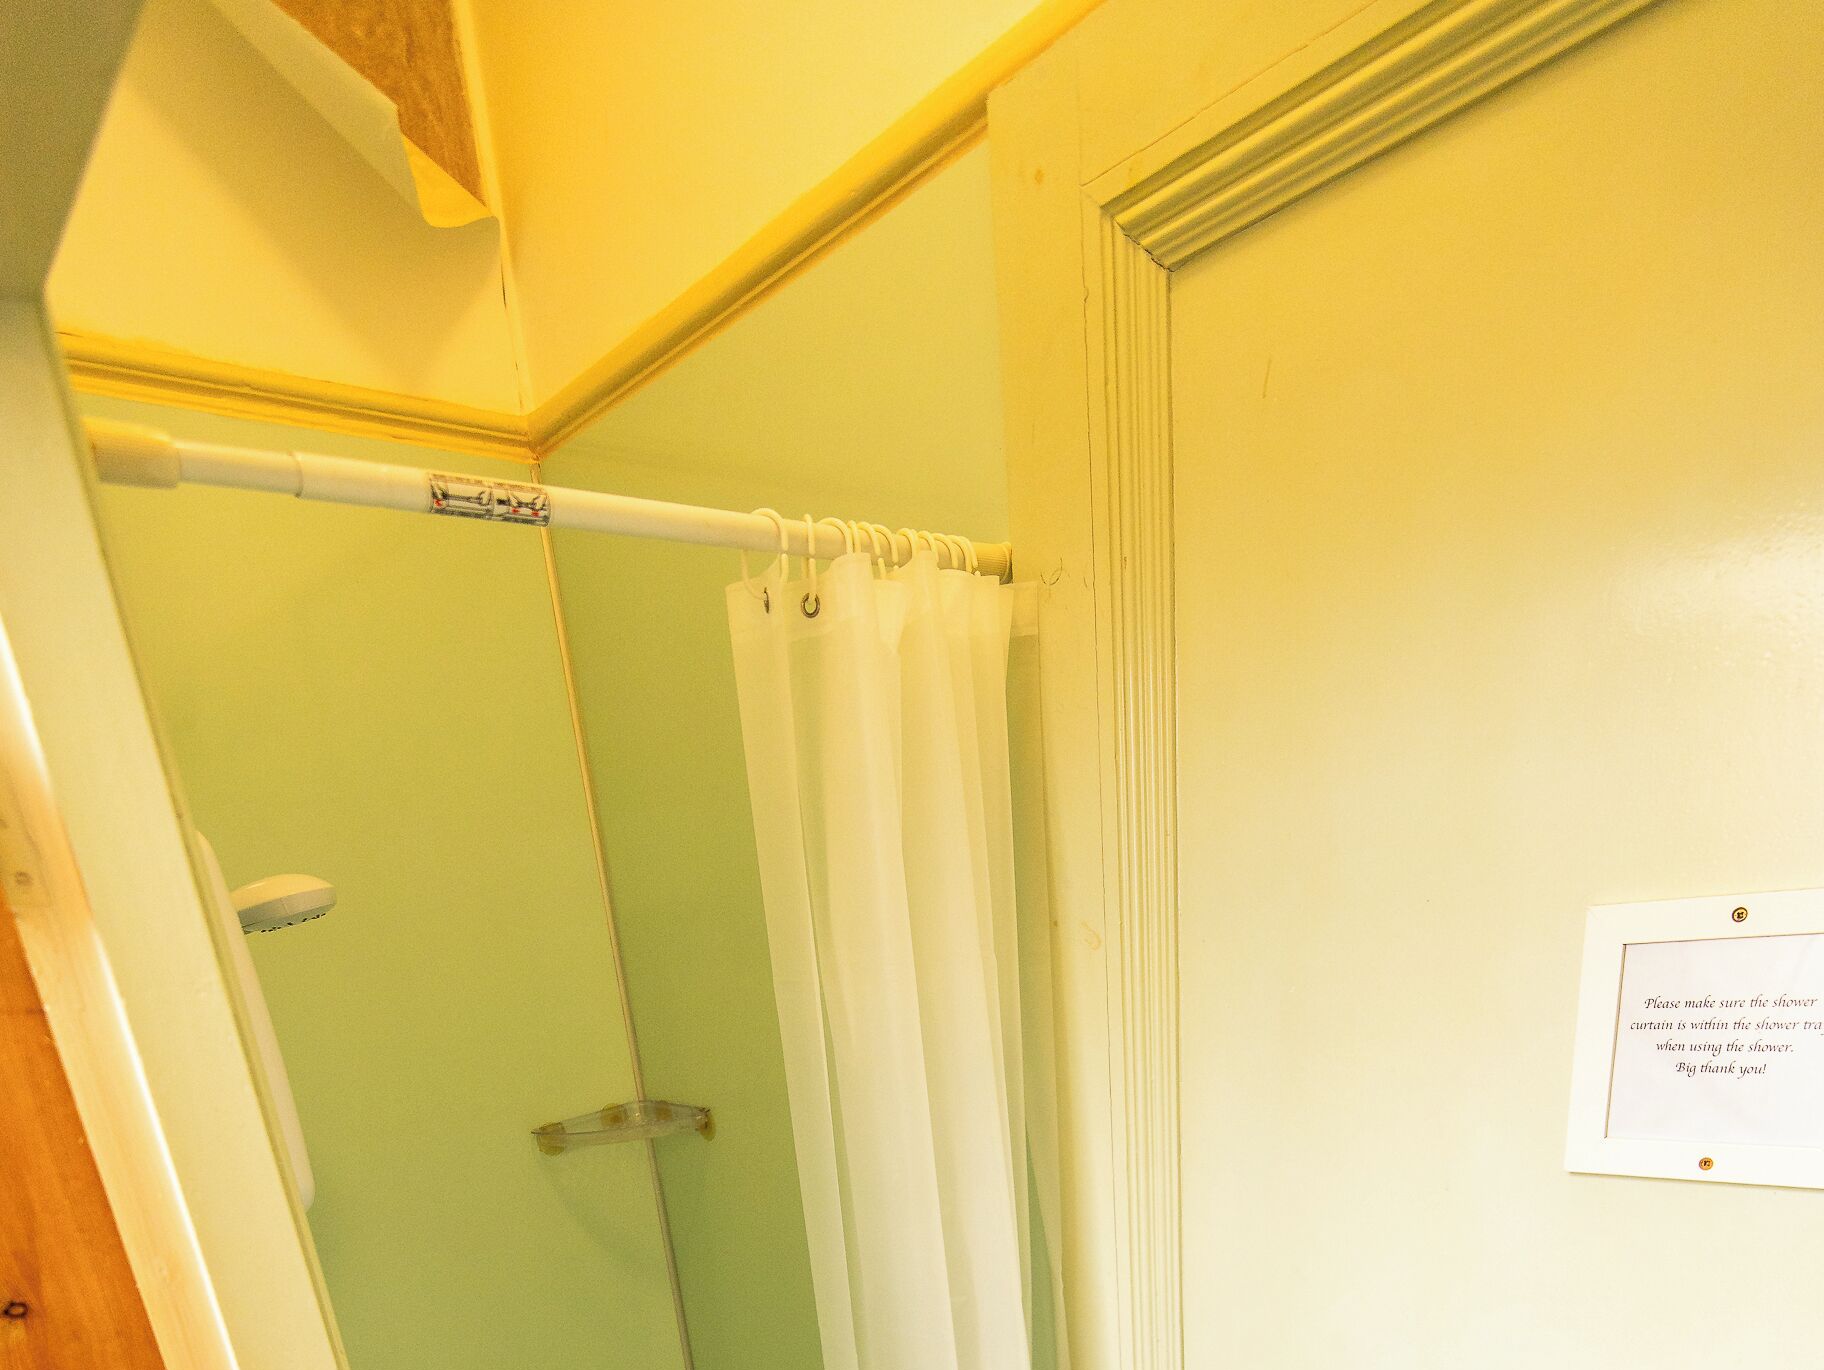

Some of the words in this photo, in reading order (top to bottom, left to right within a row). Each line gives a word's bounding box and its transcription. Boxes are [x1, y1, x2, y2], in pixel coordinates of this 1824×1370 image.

[1644, 996, 1681, 1010] Please
[1684, 995, 1716, 1008] make
[1719, 998, 1746, 1008] sure
[1750, 994, 1769, 1008] the
[1772, 993, 1818, 1008] shower
[1630, 1019, 1673, 1030] curtain
[1677, 1020, 1686, 1030] is
[1690, 1017, 1729, 1031] within
[1733, 1017, 1751, 1031] the
[1755, 1017, 1800, 1031] shower
[1803, 1020, 1824, 1036] tra
[1656, 1038, 1685, 1052] when
[1689, 1042, 1722, 1057] using
[1726, 1038, 1744, 1053] the
[1747, 1038, 1794, 1053] shower.
[1675, 1061, 1697, 1078] Big
[1700, 1060, 1736, 1075] thank
[1737, 1063, 1767, 1080] you!
